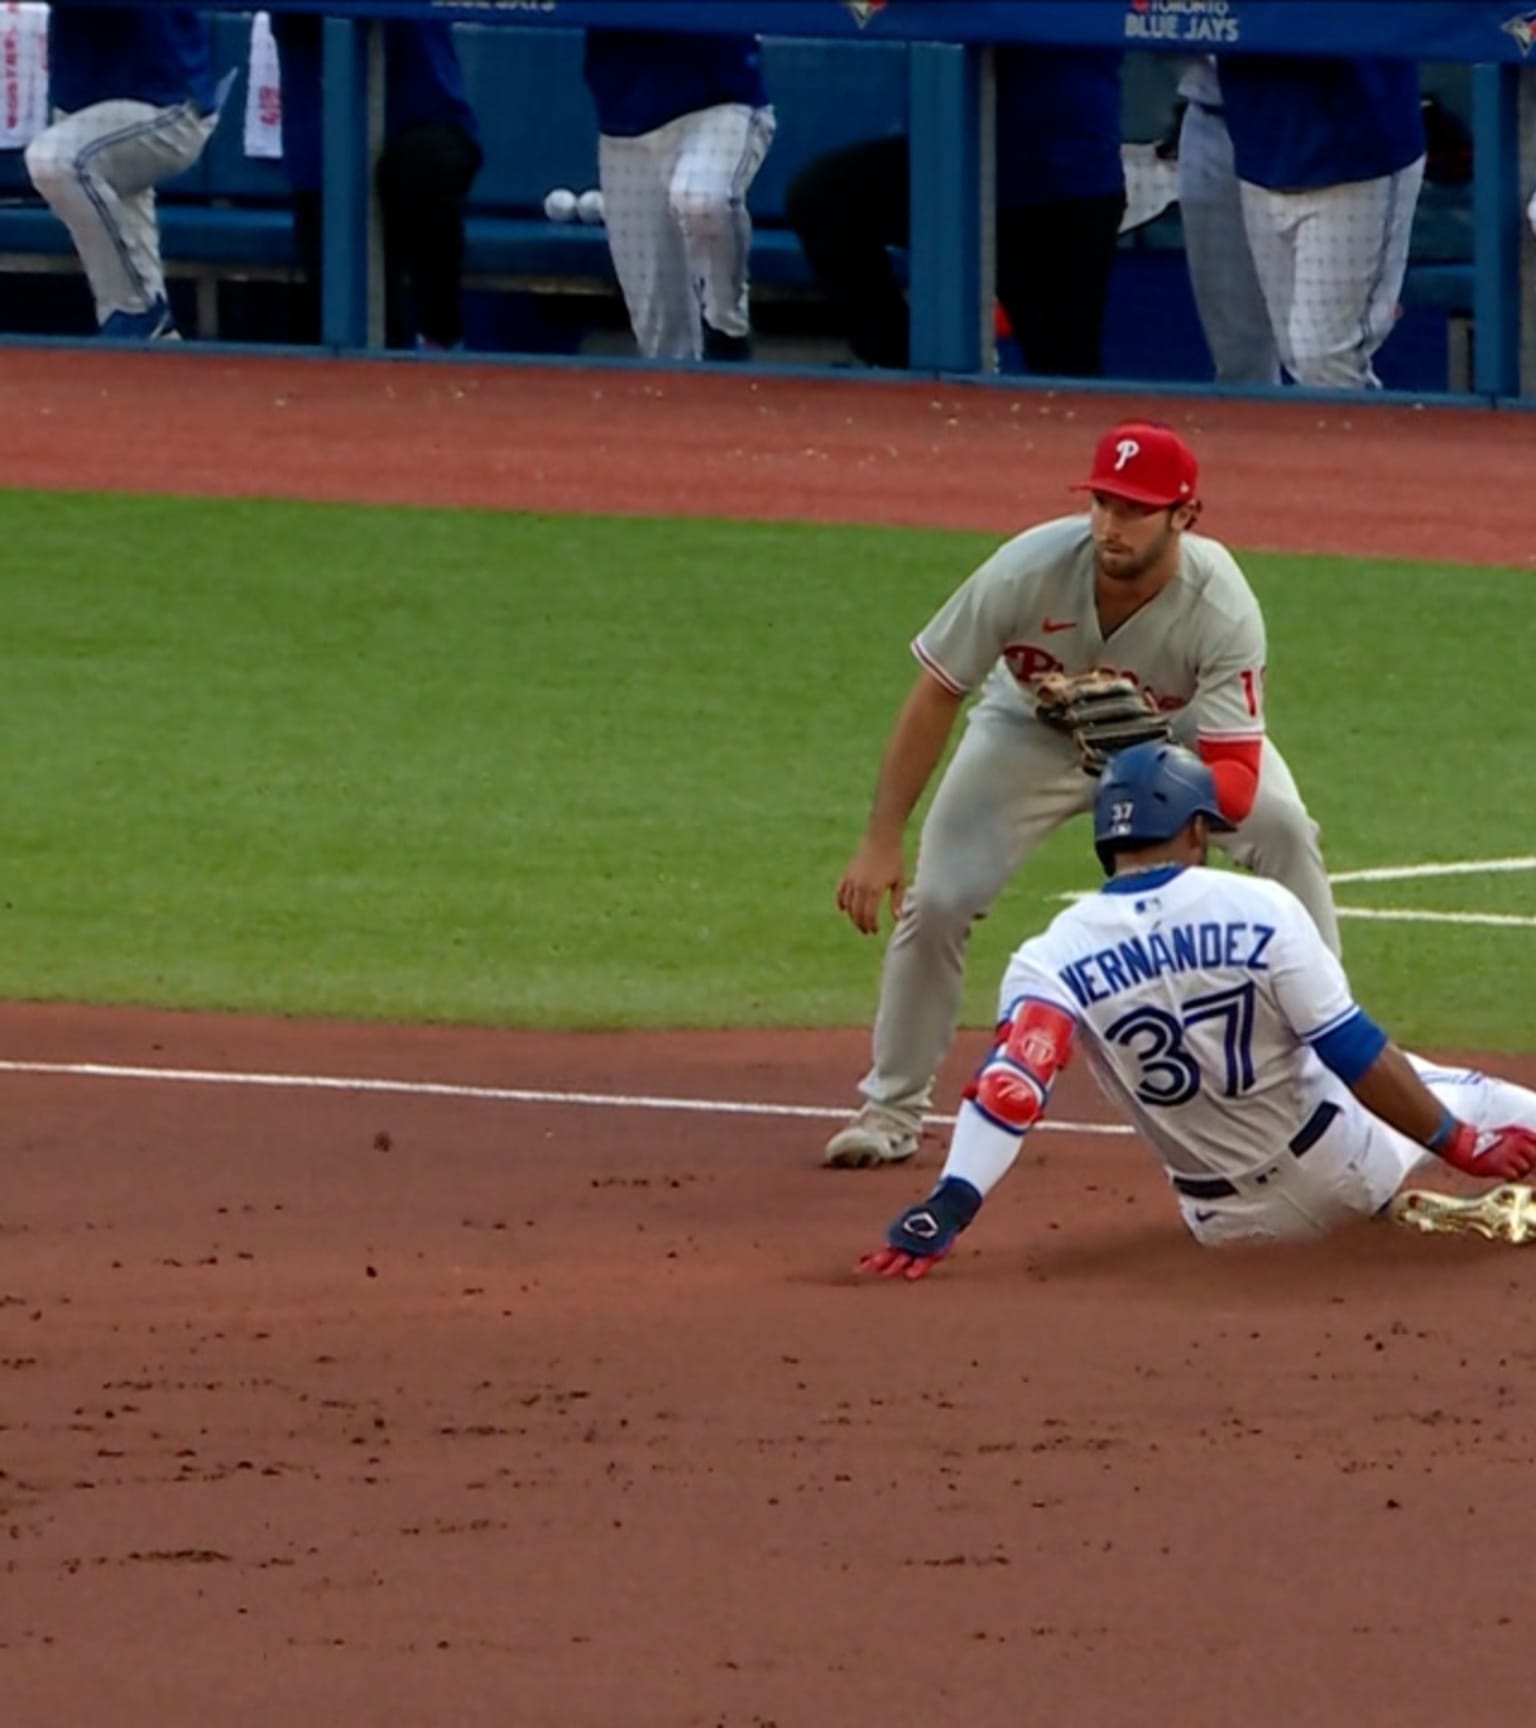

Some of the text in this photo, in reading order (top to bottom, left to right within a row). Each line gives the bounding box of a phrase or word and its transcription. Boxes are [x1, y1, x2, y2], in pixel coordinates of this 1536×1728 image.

[1124, 14, 1239, 42] BLUE JAYS
[1114, 439, 1140, 471] P
[1112, 802, 1133, 820] 37
[1104, 979, 1257, 1107] 37
